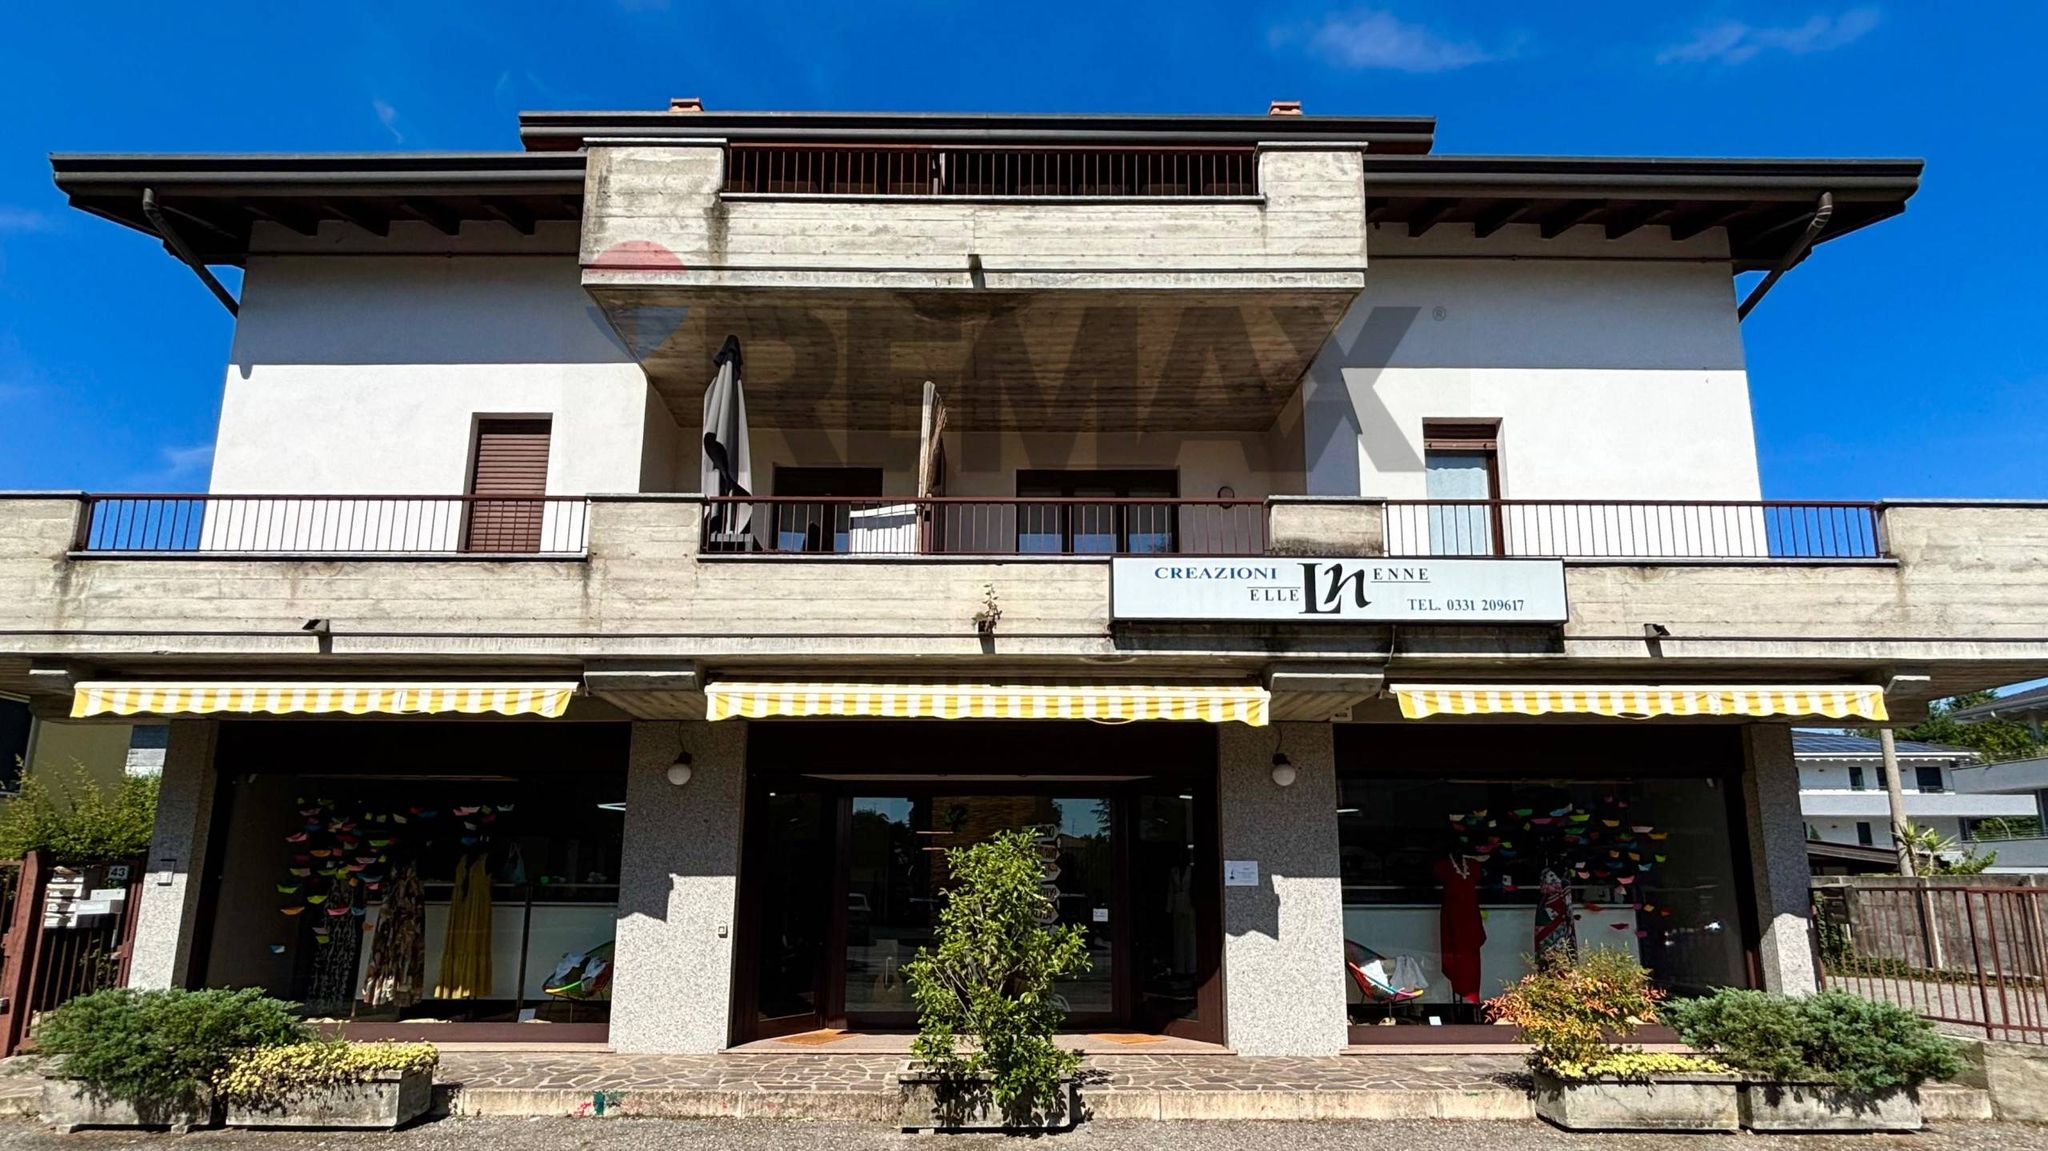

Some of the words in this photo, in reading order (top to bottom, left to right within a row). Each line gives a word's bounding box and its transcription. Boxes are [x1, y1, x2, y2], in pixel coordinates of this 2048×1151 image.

[1154, 567, 1278, 580] CREAZIONI
[1373, 567, 1429, 580] ENNE
[1250, 589, 1300, 602] ELLE
[1406, 599, 1441, 611] TEL.
[1446, 599, 1476, 611] 0331
[1482, 599, 1525, 611] 209617
[110, 867, 125, 877] 43
